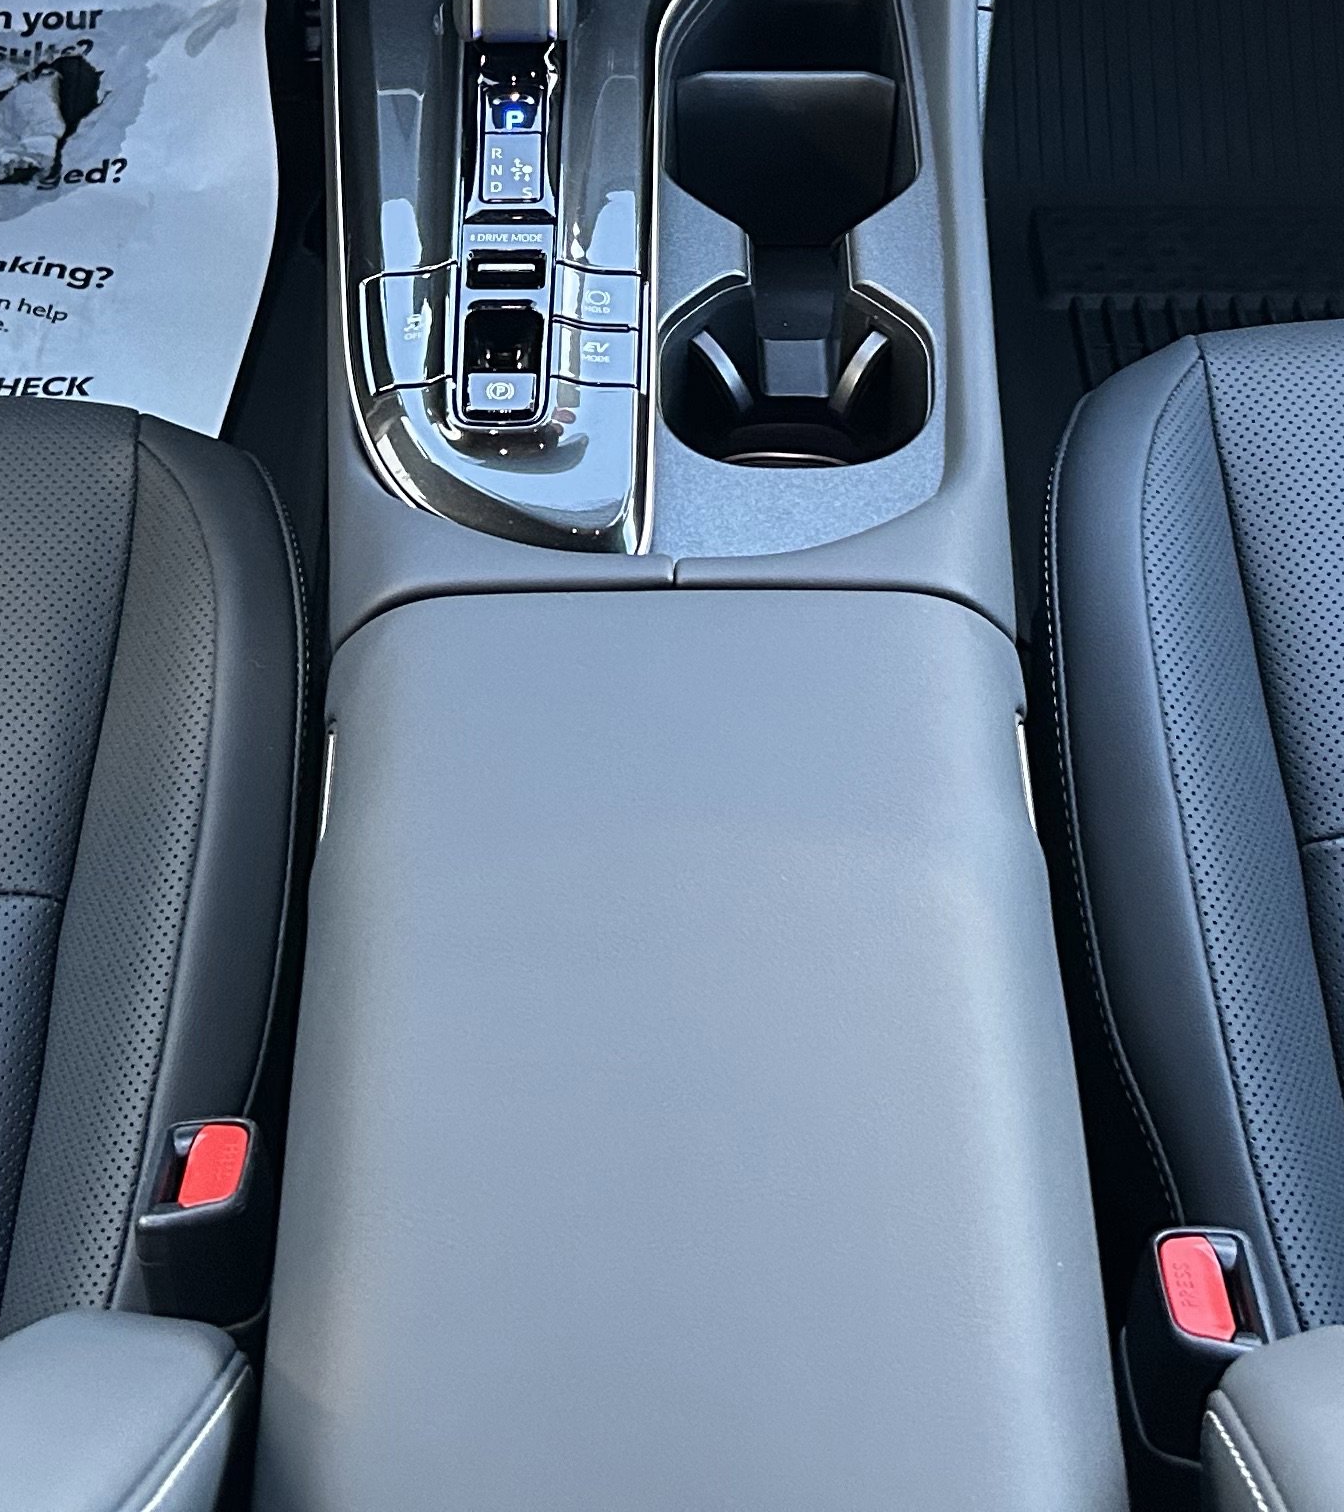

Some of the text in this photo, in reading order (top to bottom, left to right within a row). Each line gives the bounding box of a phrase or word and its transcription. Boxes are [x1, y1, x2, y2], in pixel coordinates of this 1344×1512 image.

[20, 9, 104, 38] your
[505, 109, 524, 130] P
[492, 148, 503, 160] R
[491, 164, 503, 176] N
[491, 181, 503, 194] D
[522, 187, 533, 199] S
[476, 233, 544, 243] DRIVE MODE
[17, 297, 69, 324] help
[584, 306, 611, 314] HOLD
[582, 341, 610, 354] EV
[582, 354, 610, 363] MODE
